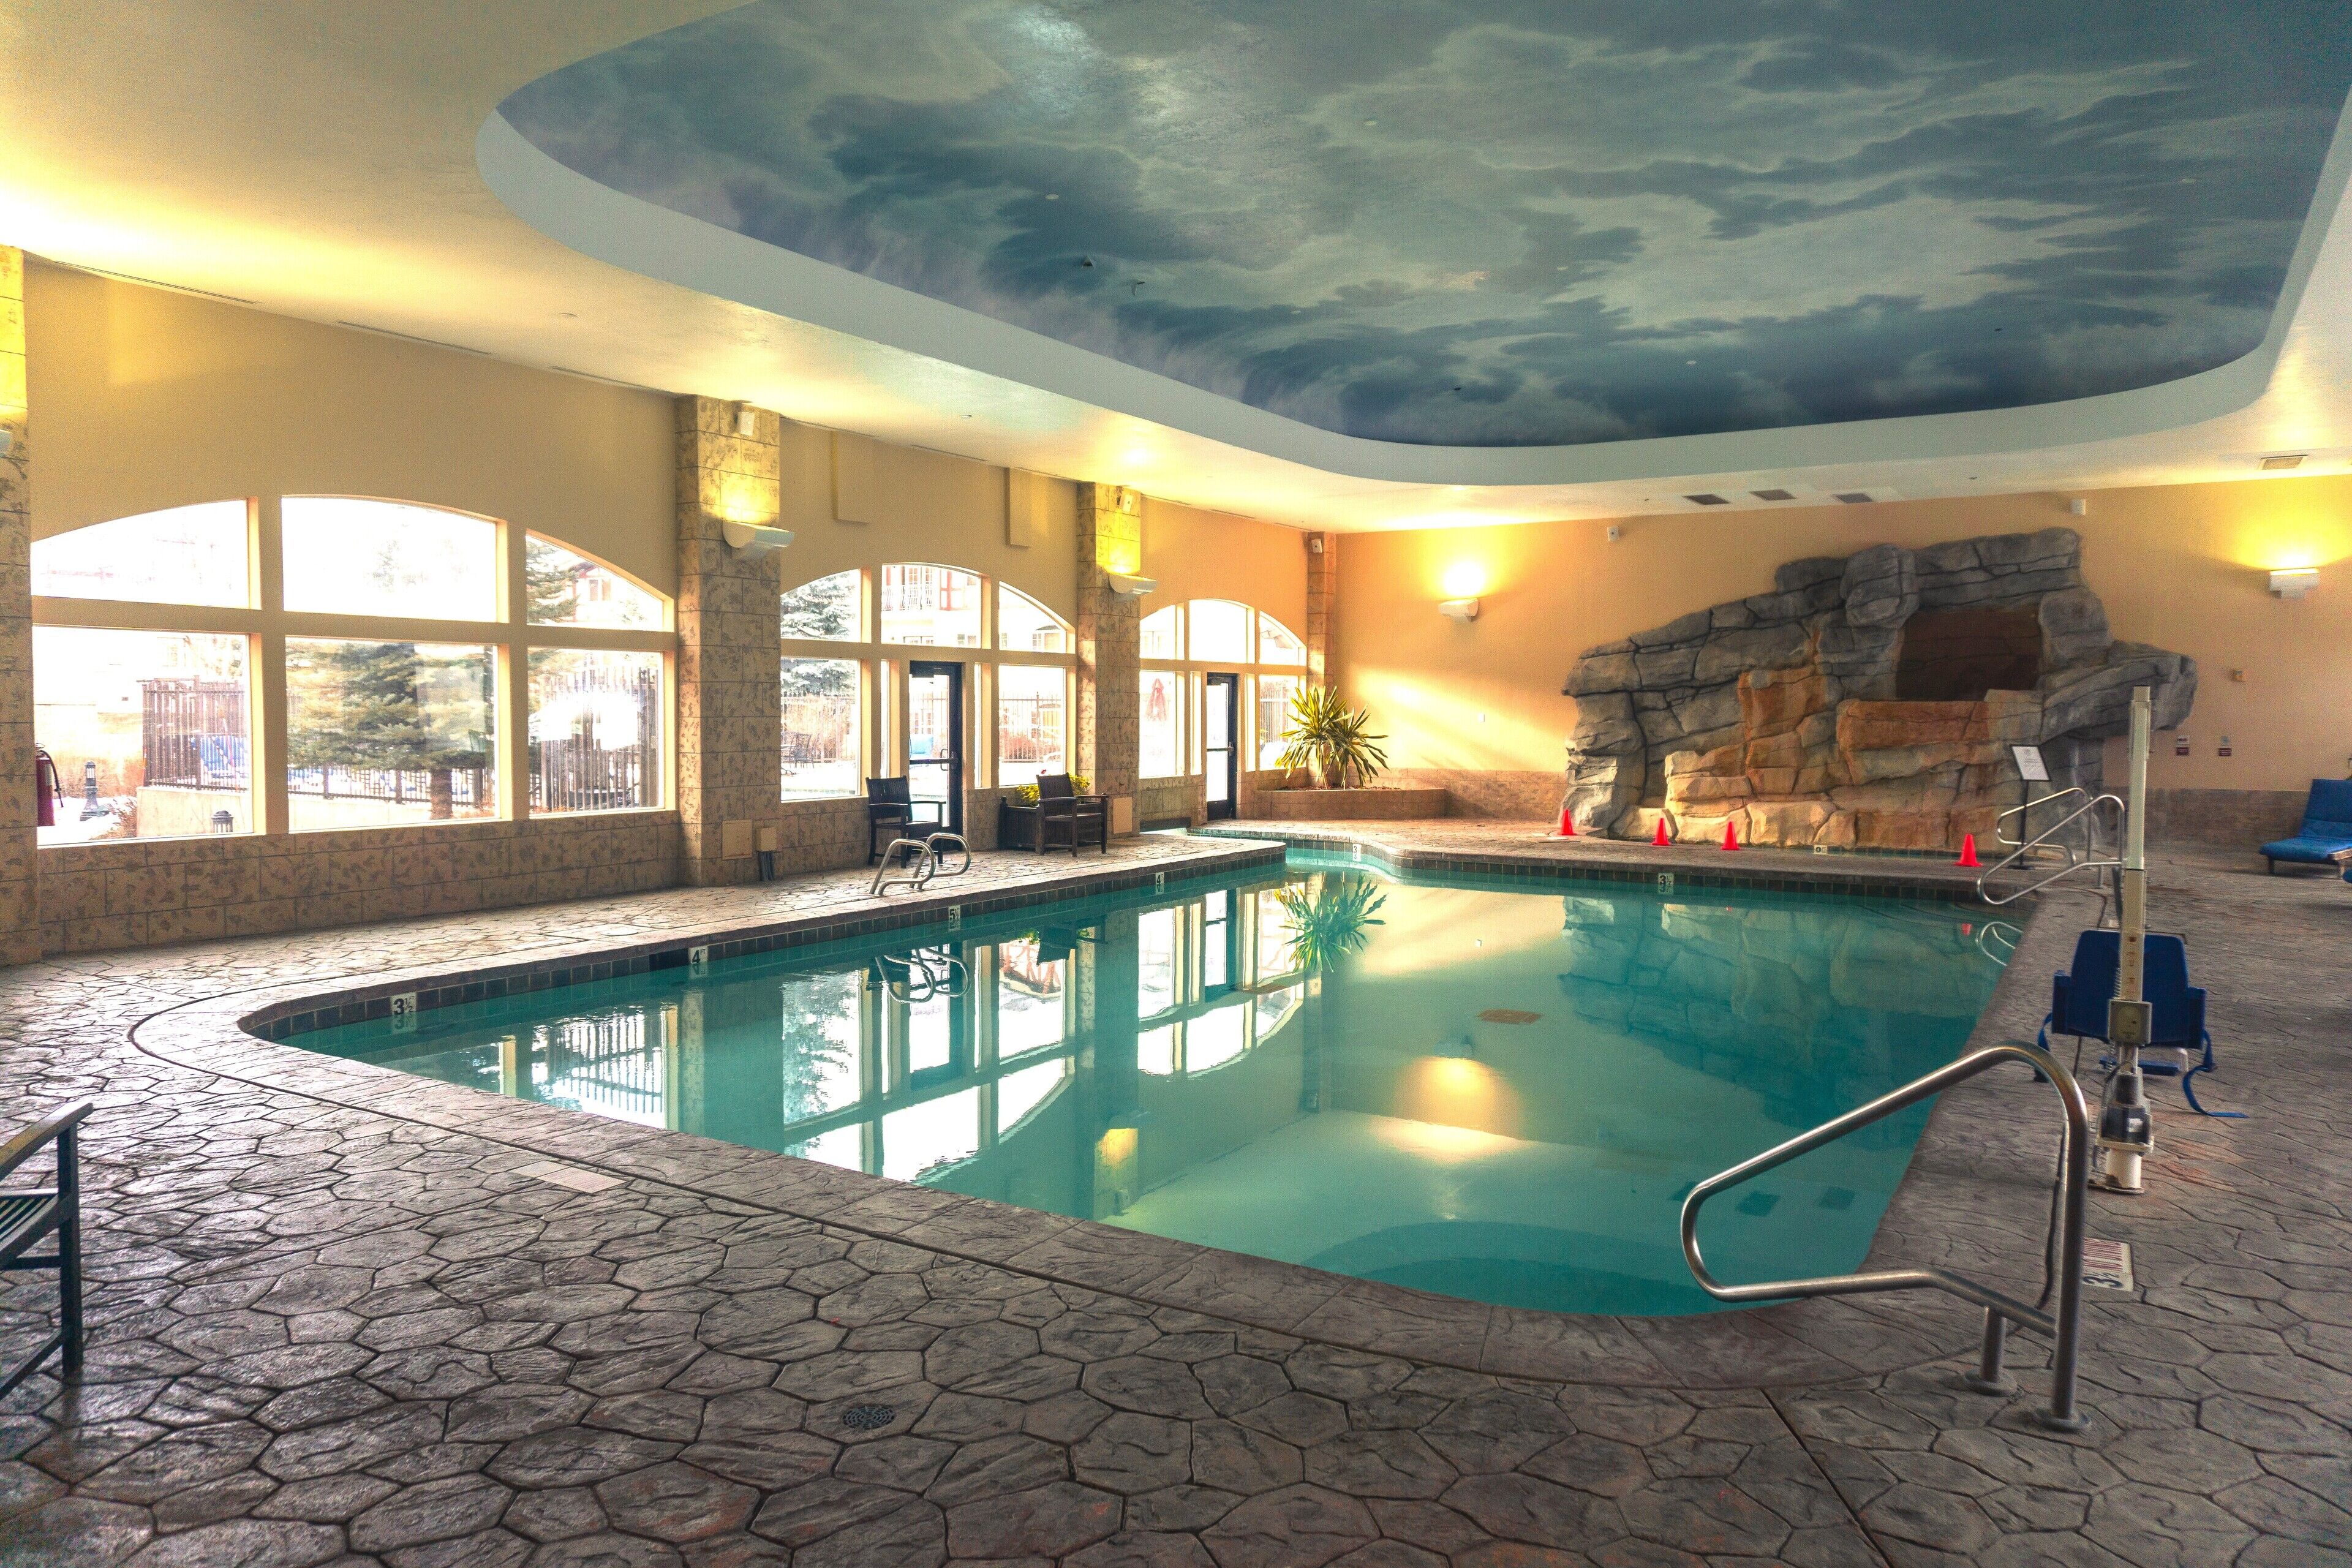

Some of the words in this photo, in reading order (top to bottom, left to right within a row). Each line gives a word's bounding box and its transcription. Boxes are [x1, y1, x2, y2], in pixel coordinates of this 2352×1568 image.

[1157, 875, 1161, 884] 4
[949, 909, 955, 921] 5
[692, 950, 700, 963] 4
[393, 998, 404, 1015] 3
[2082, 1276, 2123, 1289] 3
